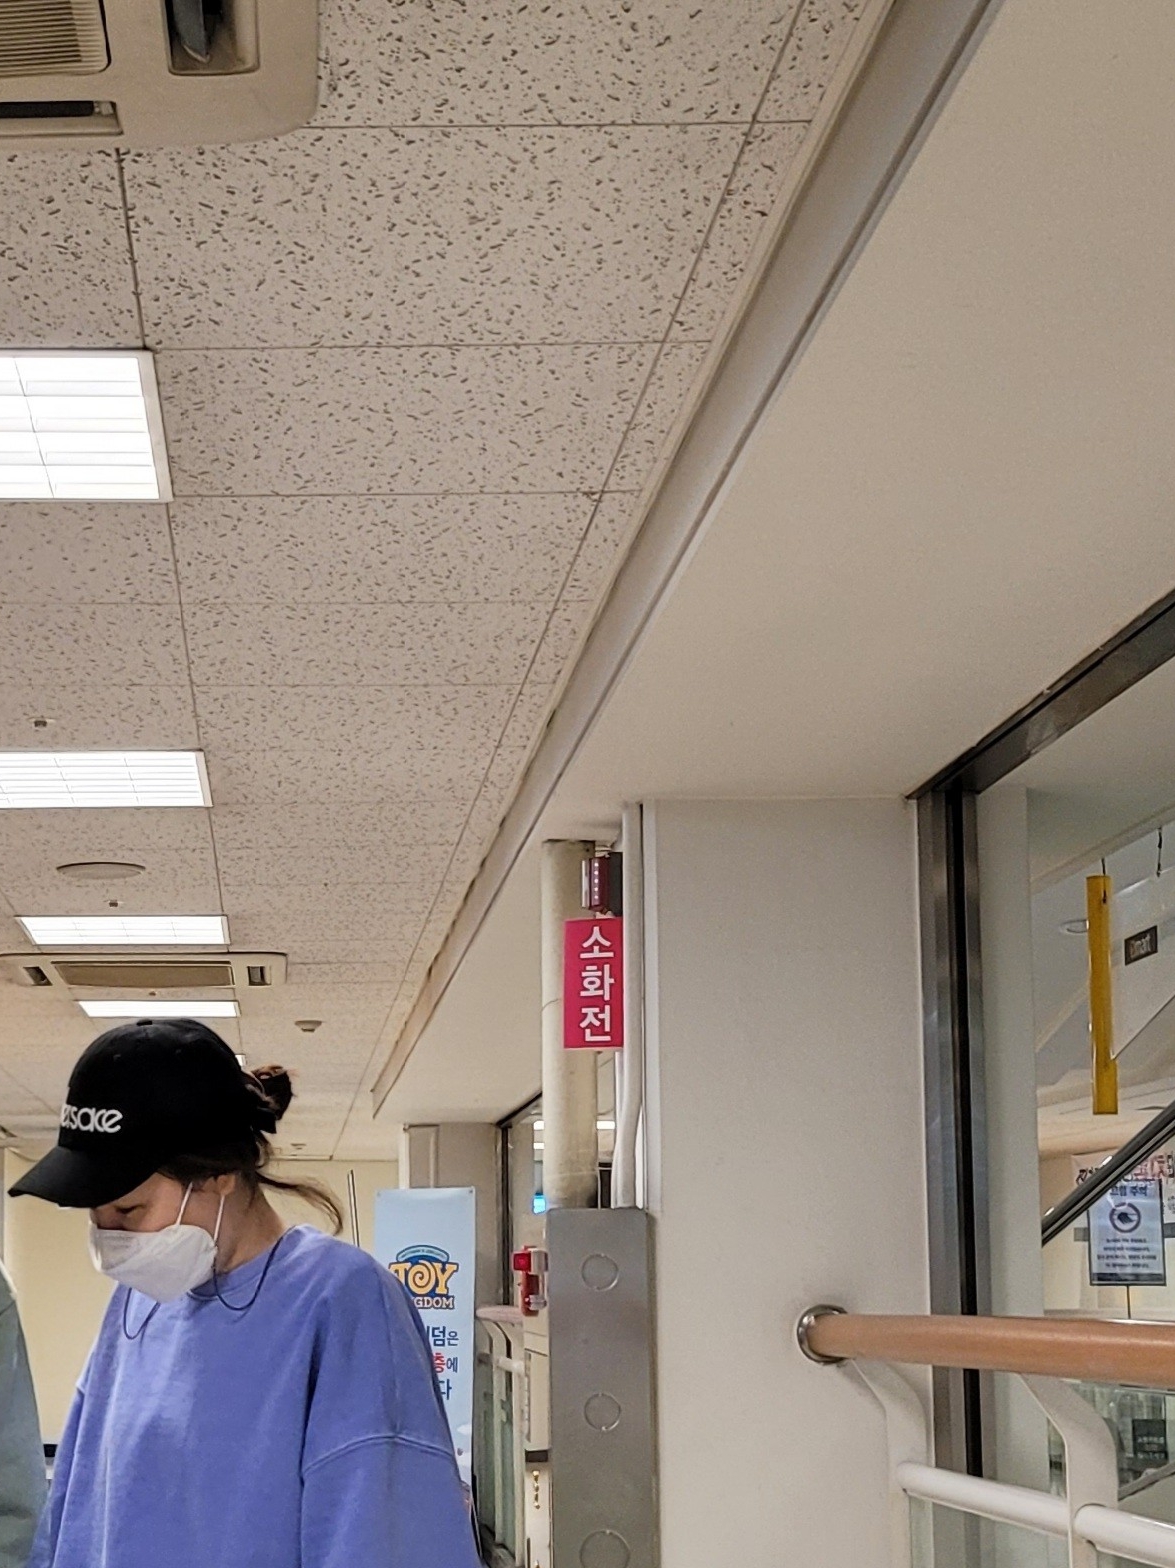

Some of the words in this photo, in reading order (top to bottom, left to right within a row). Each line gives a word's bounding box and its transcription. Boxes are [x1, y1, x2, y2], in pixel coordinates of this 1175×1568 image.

[579, 926, 615, 1042] 소화전
[388, 1260, 459, 1295] TOY
[413, 1297, 454, 1309] GDOM
[426, 1325, 460, 1347] 덤은
[433, 1352, 459, 1373] 층에
